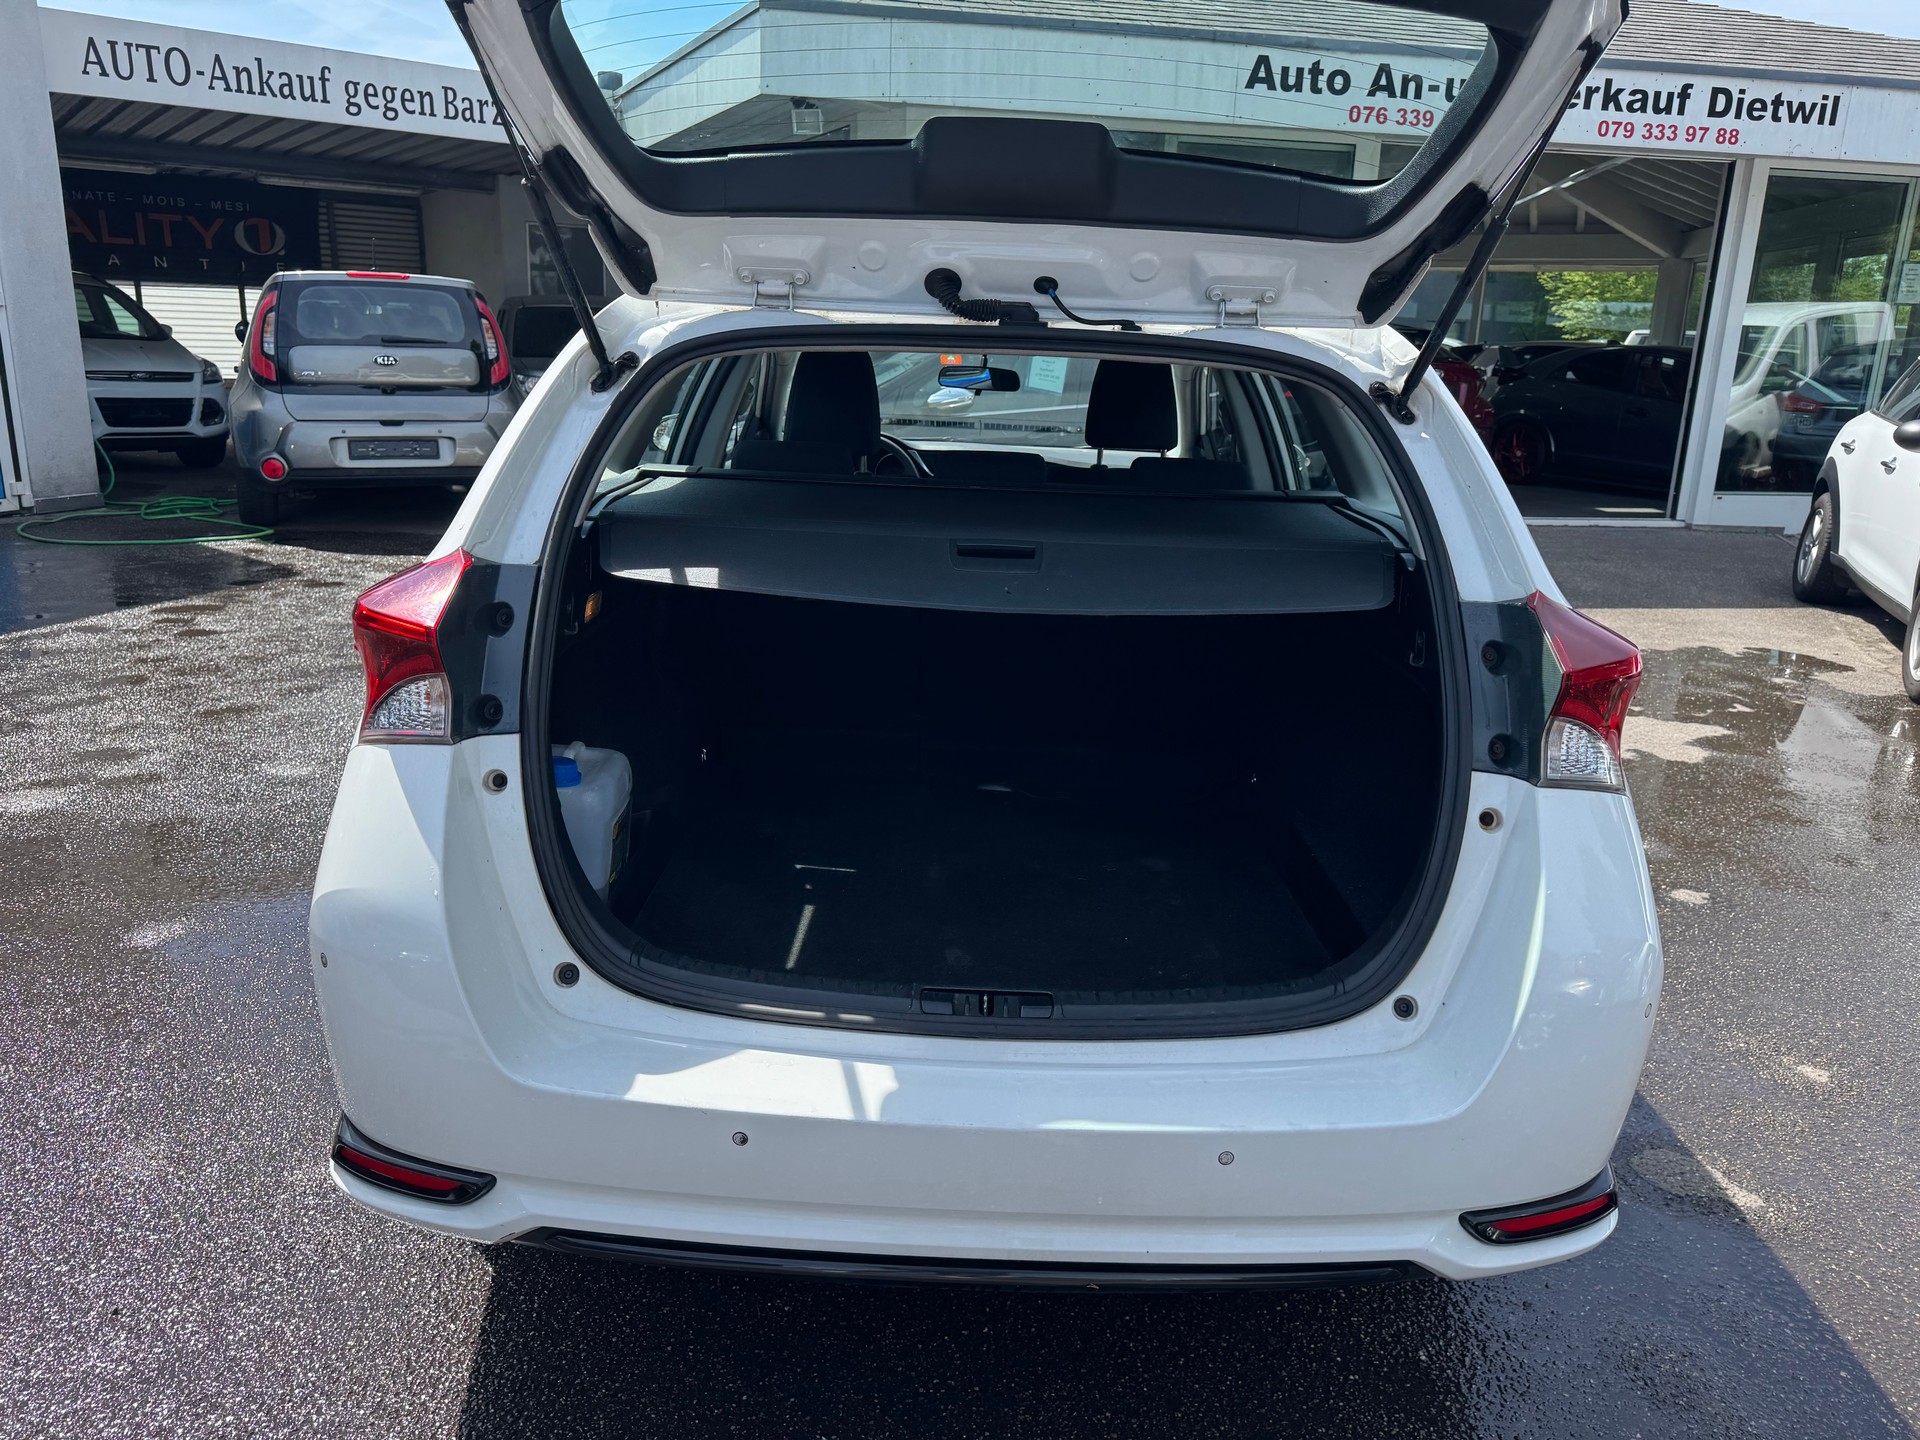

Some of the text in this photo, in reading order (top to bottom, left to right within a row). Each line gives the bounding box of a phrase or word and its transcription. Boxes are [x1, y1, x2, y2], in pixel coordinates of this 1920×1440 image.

[81, 36, 332, 105] AUTO-Ankauf
[344, 79, 437, 122] gegen
[1244, 54, 1352, 96] Auto
[1707, 86, 1840, 126] Dietwil
[1348, 105, 1435, 128] 076 339
[1597, 120, 1740, 146] 079 333 97 88
[143, 194, 186, 208] MOIS
[211, 200, 251, 212] MESI
[376, 356, 397, 366] KIA
